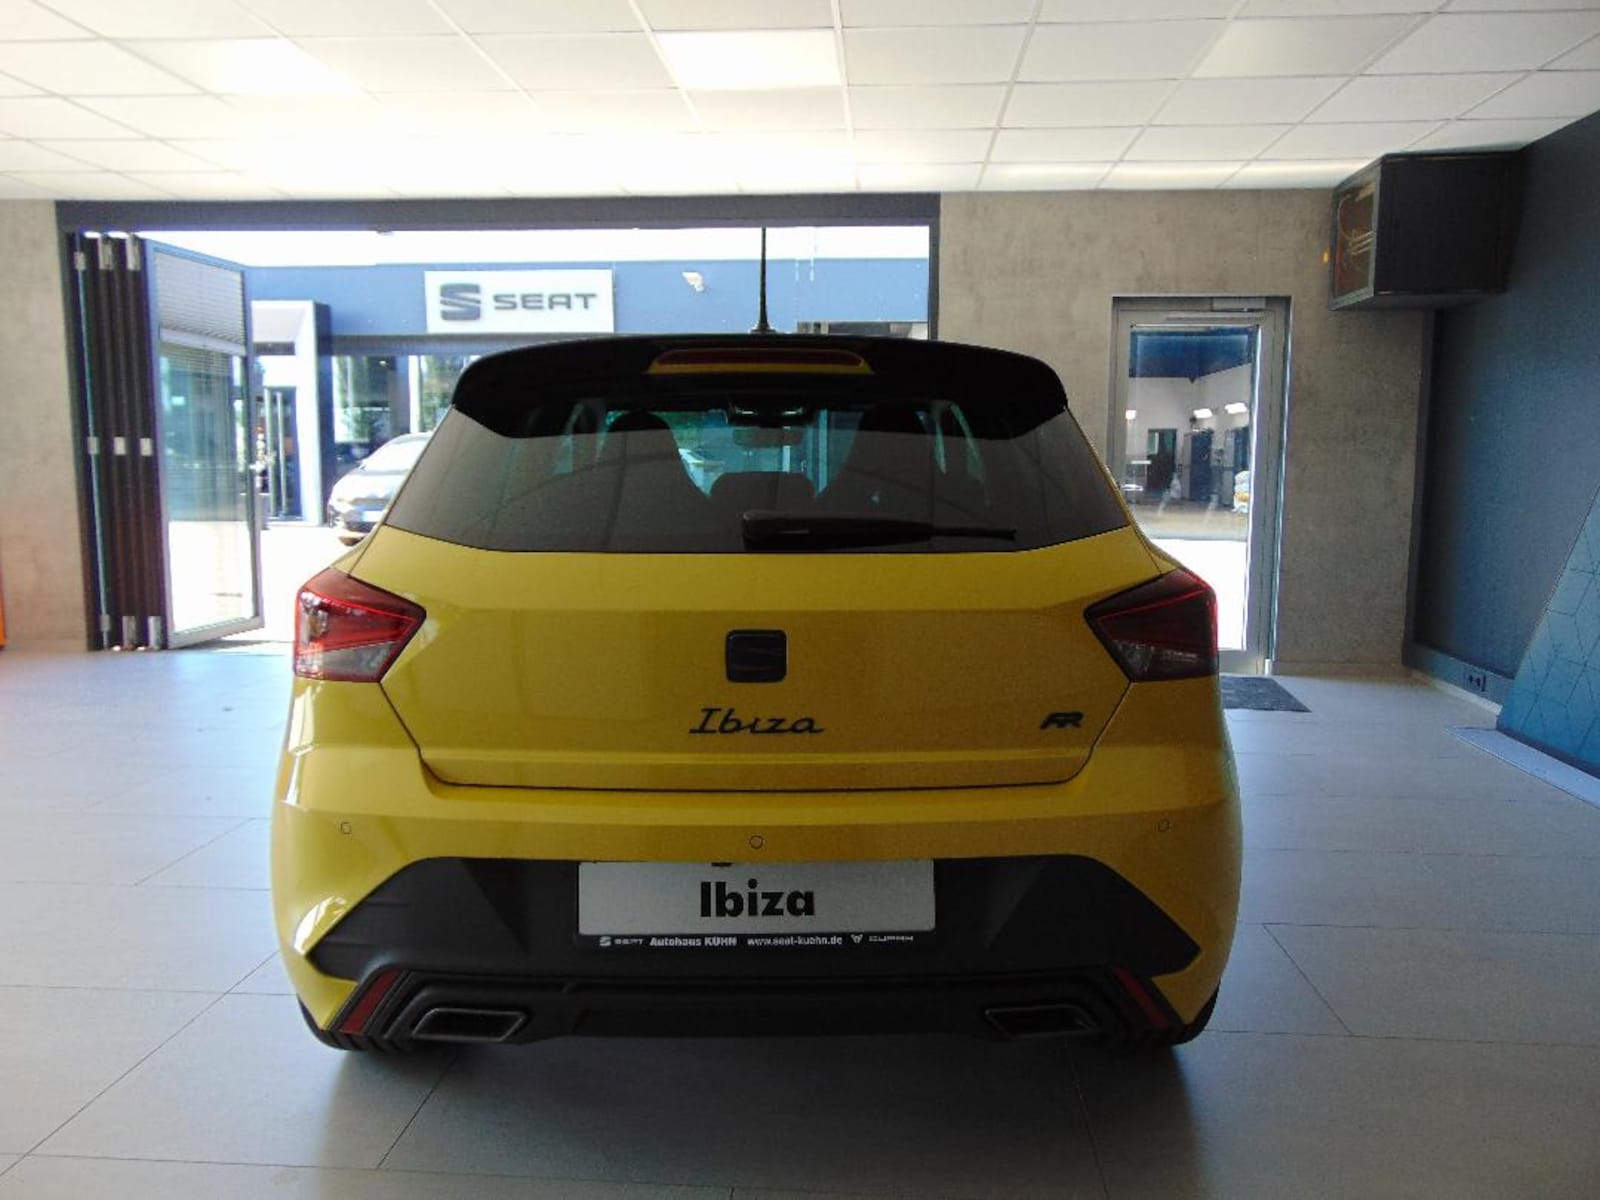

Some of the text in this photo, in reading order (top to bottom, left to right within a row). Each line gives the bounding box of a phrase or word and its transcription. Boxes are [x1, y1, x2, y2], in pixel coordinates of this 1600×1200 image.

[492, 293, 597, 310] SEAT
[688, 707, 825, 734] Ibiza
[700, 878, 815, 918] Ibiza
[649, 935, 702, 947] Autohaus
